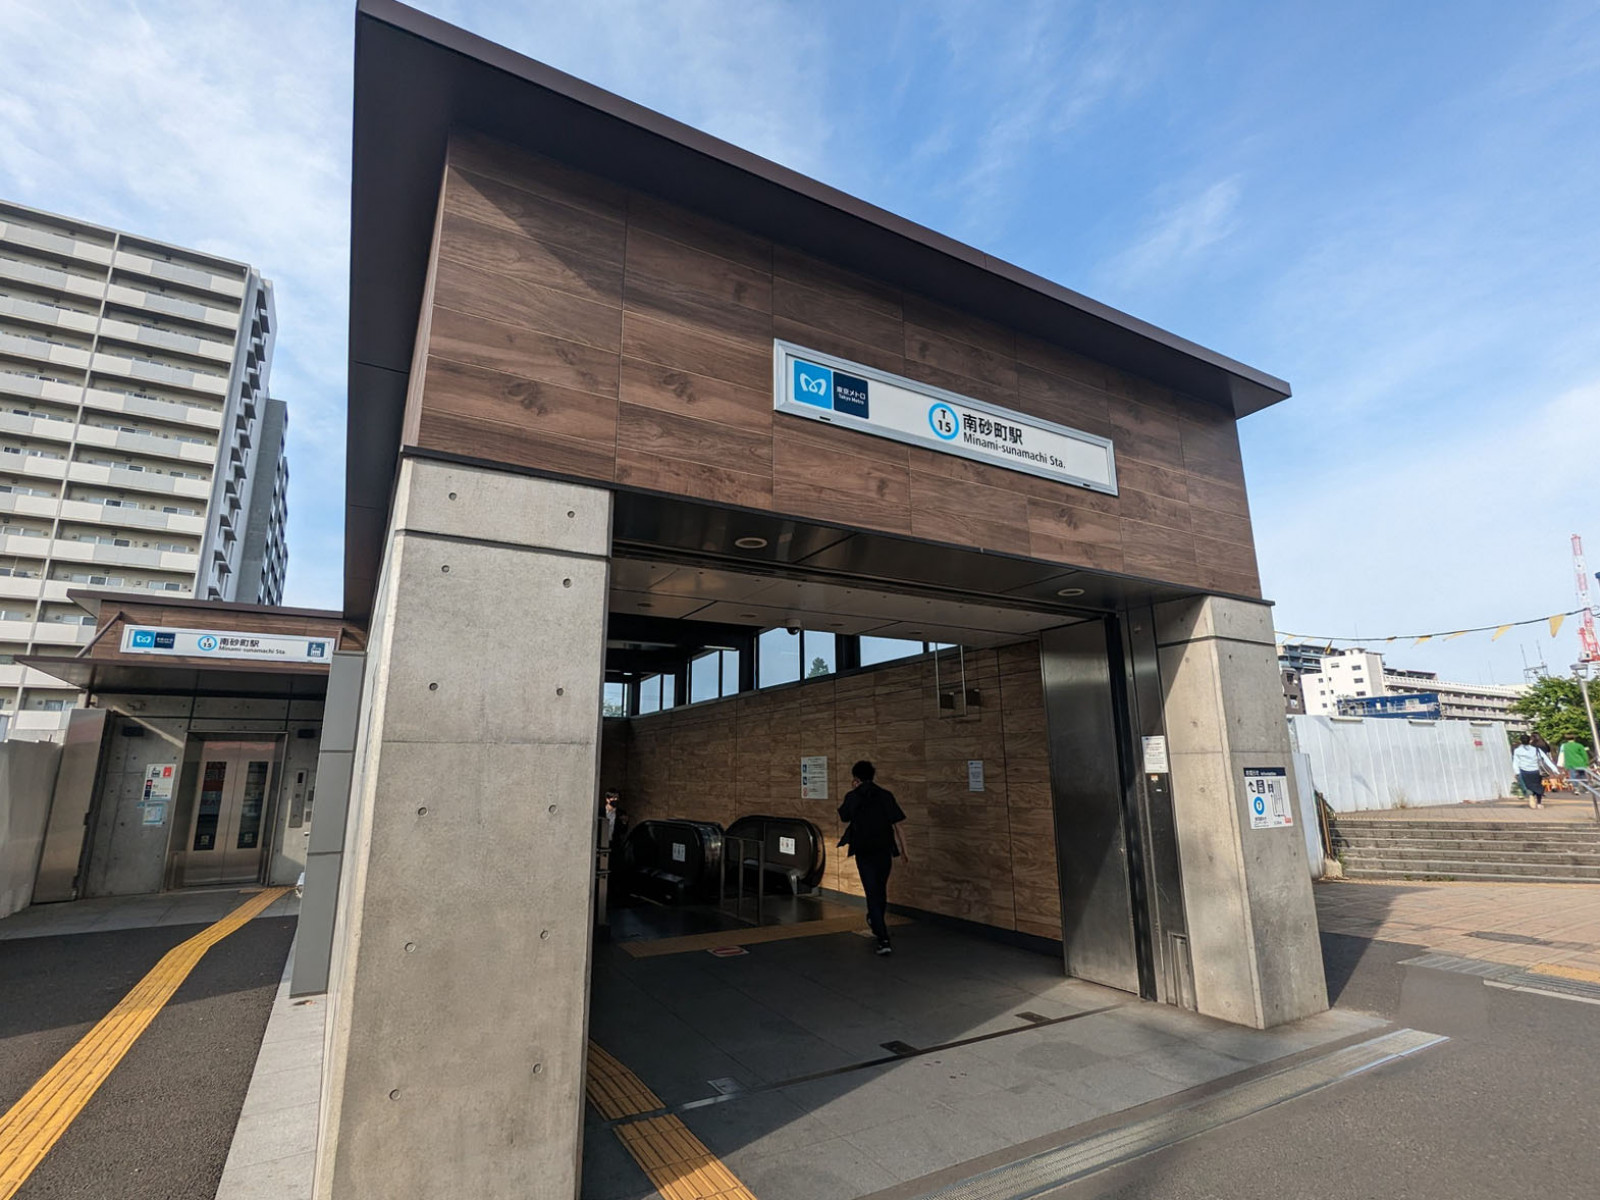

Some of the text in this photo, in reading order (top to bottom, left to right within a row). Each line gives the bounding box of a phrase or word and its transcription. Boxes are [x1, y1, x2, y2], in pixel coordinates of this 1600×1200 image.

[940, 409, 947, 419] T
[938, 419, 952, 433] 15
[962, 413, 1024, 446] 南砂町駅
[963, 432, 1066, 469] Minami-sunamachi Sta.
[219, 637, 260, 648] 南砂町駅
